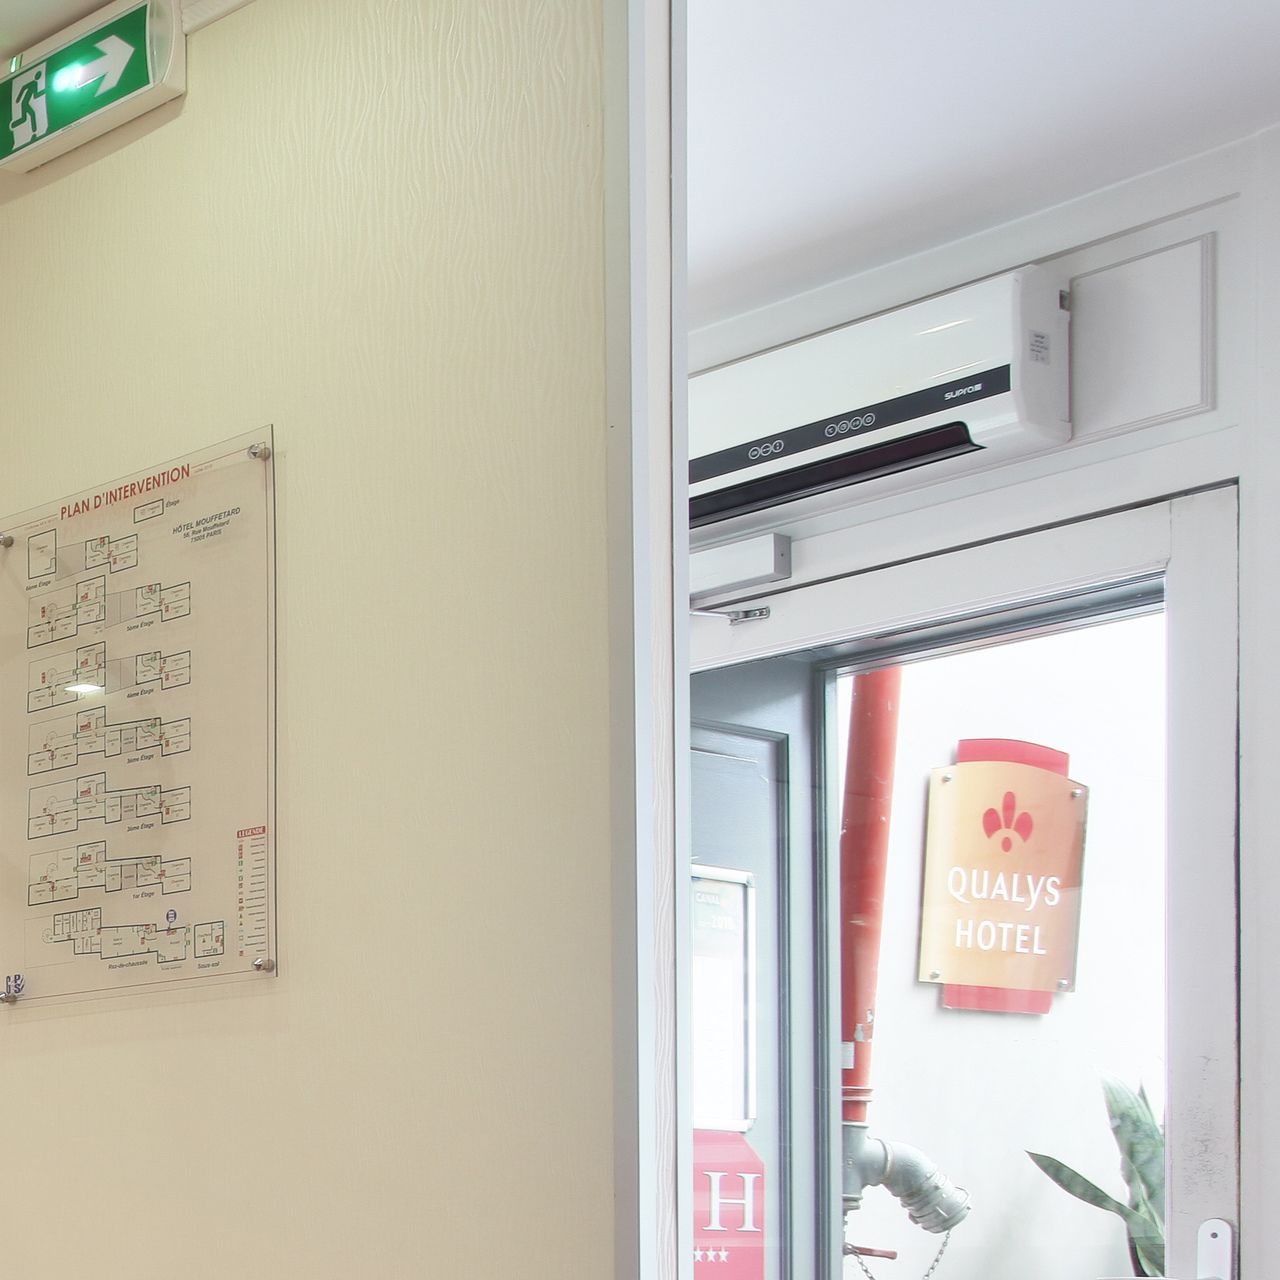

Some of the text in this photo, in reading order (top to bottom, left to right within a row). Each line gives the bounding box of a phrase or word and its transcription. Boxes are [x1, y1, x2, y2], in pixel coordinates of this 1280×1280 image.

[60, 463, 190, 520] PLAN D'INTERVENTION
[195, 507, 241, 527] MOUFFETARD
[947, 866, 1061, 911] QUALYS
[955, 918, 1047, 955] HOTEL
[703, 1171, 762, 1232] H
